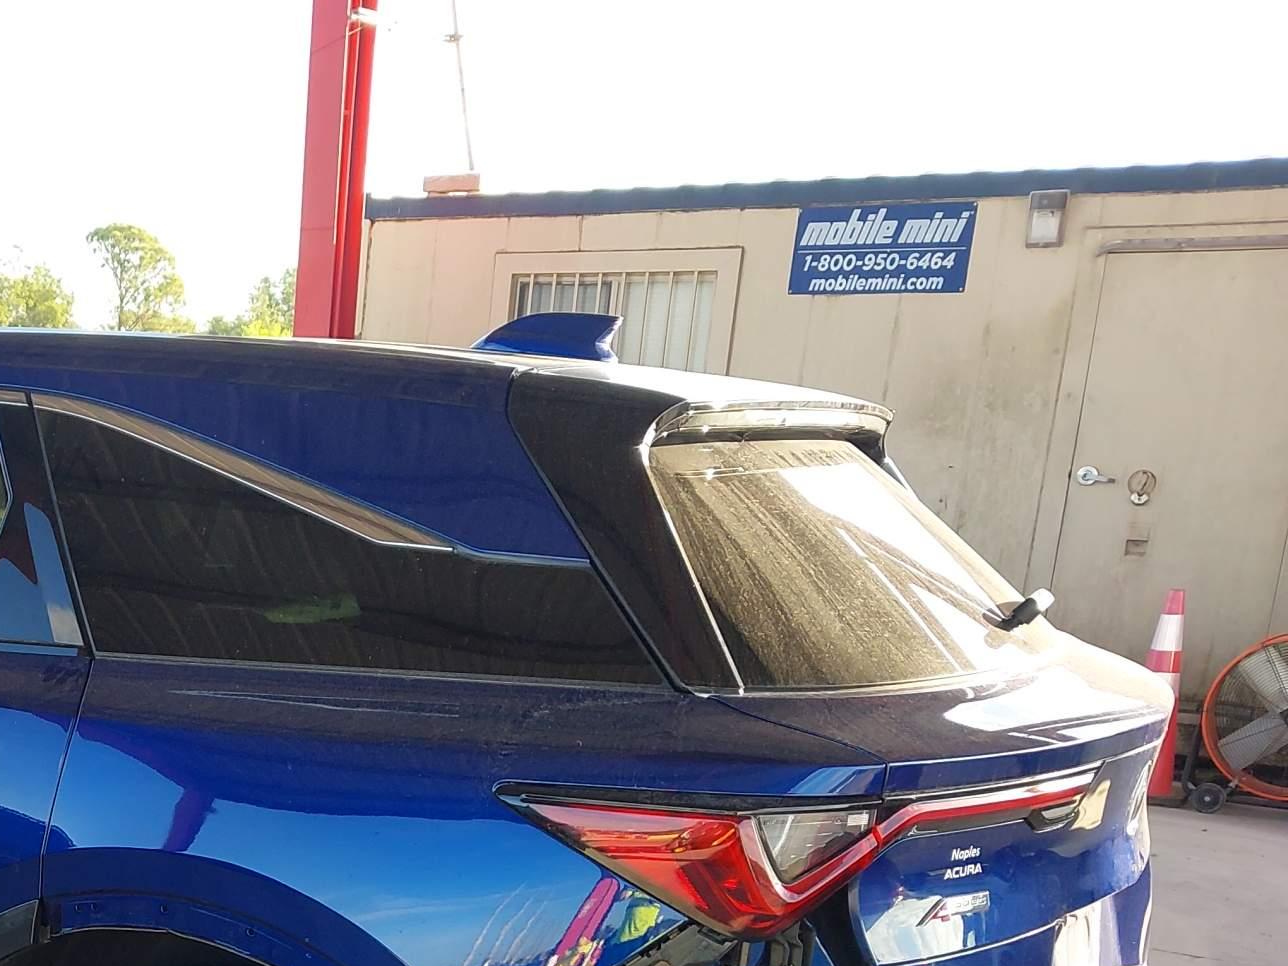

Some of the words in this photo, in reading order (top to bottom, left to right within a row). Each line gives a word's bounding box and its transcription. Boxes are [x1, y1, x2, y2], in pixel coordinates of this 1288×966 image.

[799, 208, 898, 246] mobile
[898, 211, 969, 244] mini
[803, 252, 956, 272] 1-800-950-6464
[808, 273, 944, 292] mobilemini.com
[951, 845, 981, 861] Naples
[943, 863, 983, 880] ACURA
